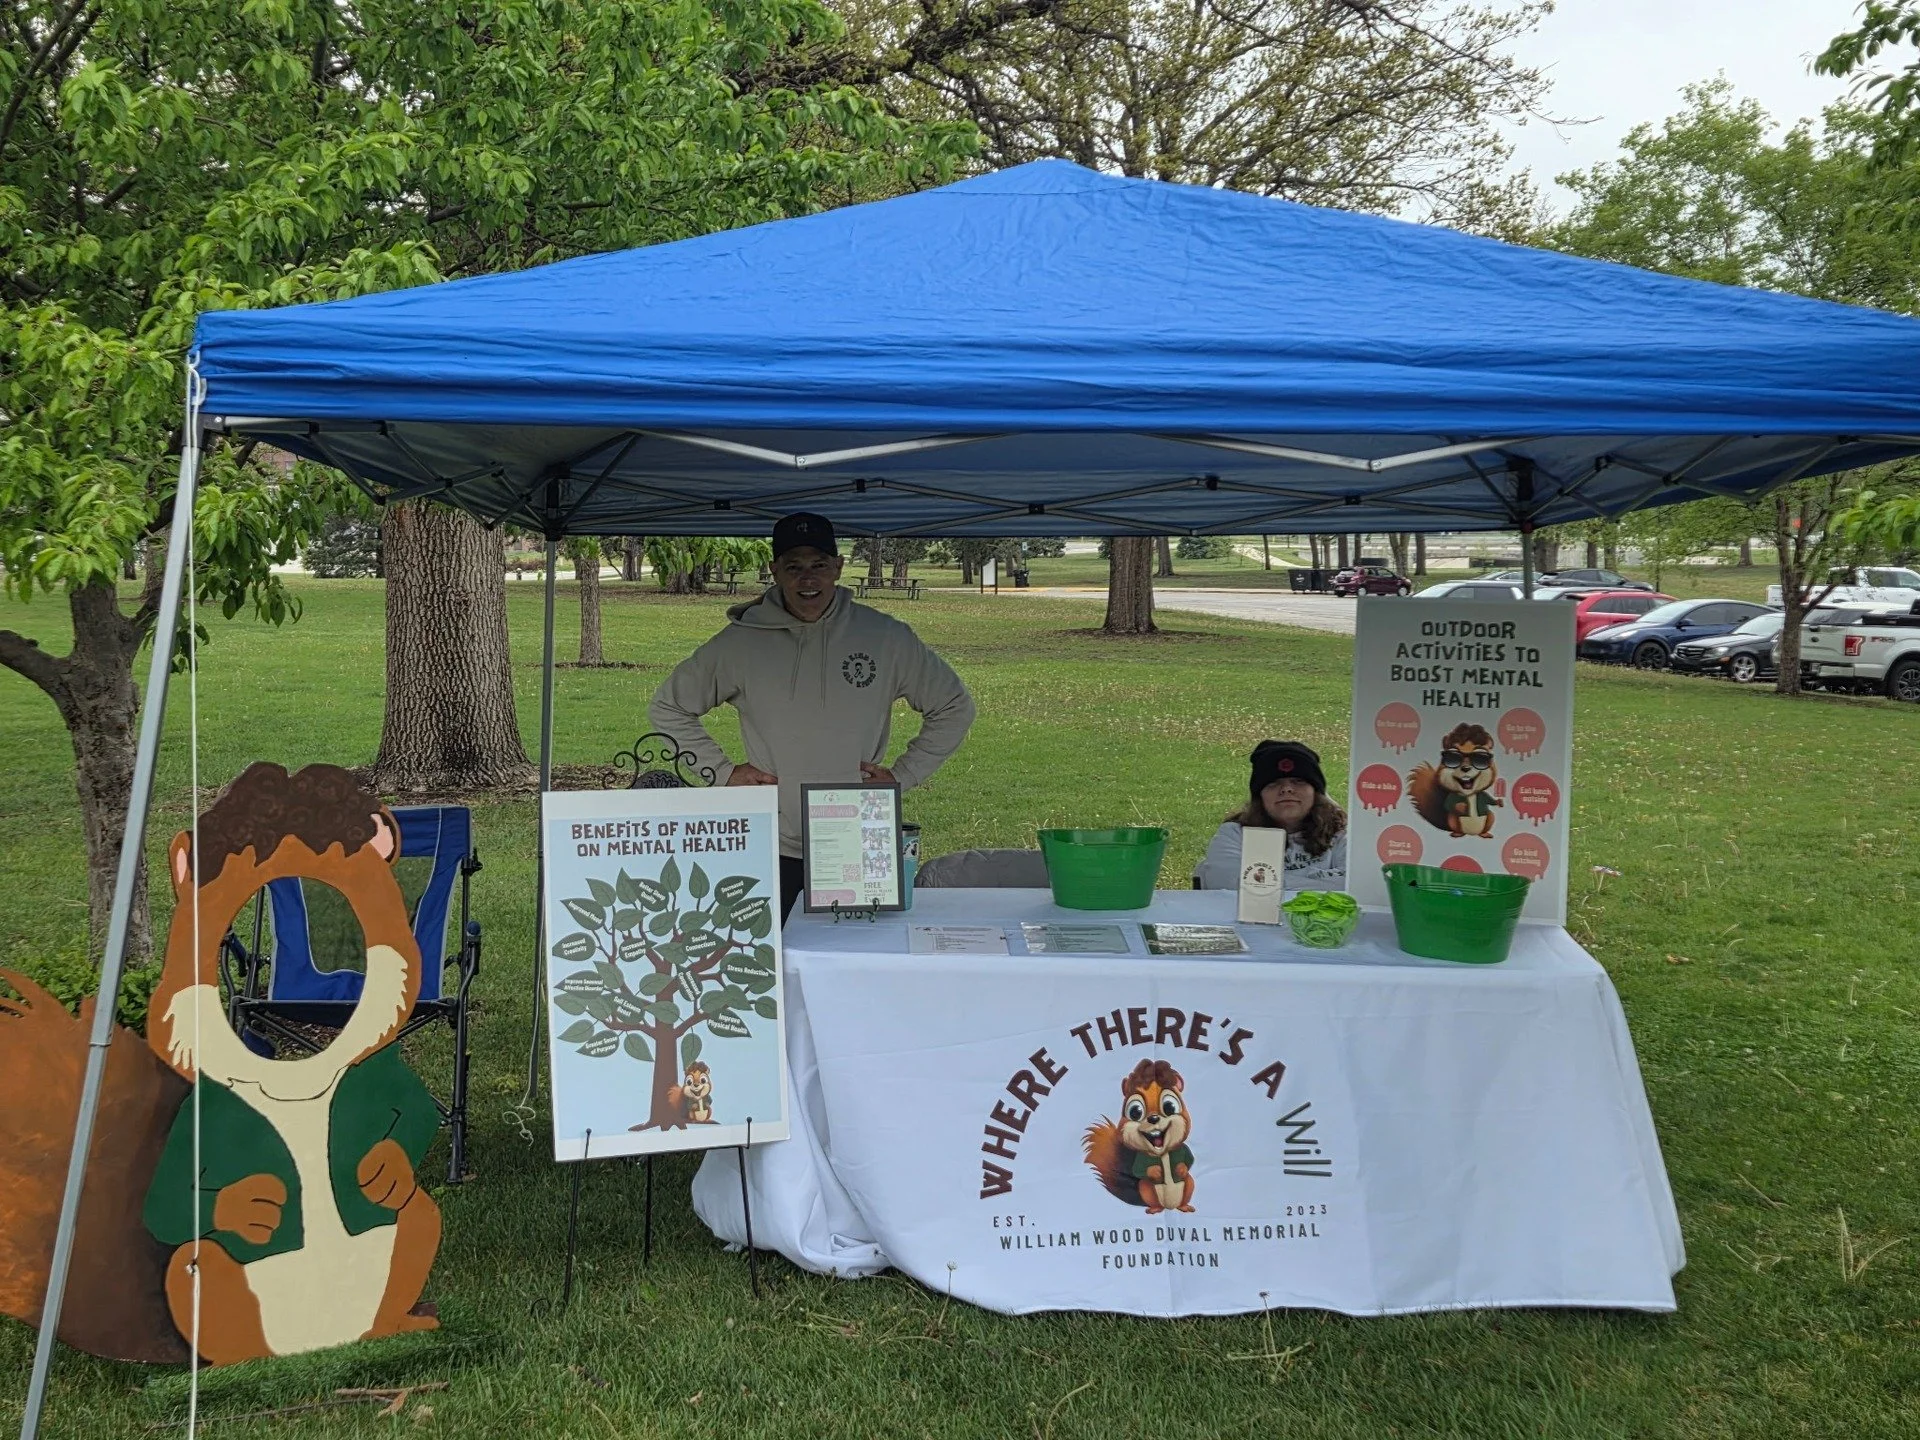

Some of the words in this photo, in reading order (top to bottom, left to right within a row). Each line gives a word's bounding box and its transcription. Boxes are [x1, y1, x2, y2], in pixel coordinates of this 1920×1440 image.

[1421, 620, 1516, 640] OUTDOOR
[1514, 646, 1540, 663] TO
[1391, 665, 1454, 684] BOOST
[1462, 668, 1543, 688] MENTAL
[1422, 689, 1500, 709] HEALTH
[658, 822, 679, 837] OF
[685, 818, 751, 835] NATURE
[577, 843, 600, 857] ON
[607, 839, 676, 855] MENTAL
[682, 836, 747, 852] HEALTH
[980, 1046, 1069, 1200] WHERE
[1070, 1007, 1254, 1066] THERE'S
[1251, 1060, 1286, 1100] A
[1276, 1101, 1333, 1178] Will
[1286, 1205, 1328, 1218] 2023
[993, 1215, 1036, 1229] EST.
[999, 1231, 1081, 1250] WILLIAM
[1092, 1226, 1146, 1246] WOOD
[1155, 1223, 1213, 1243] DUVAL
[1222, 1221, 1321, 1241] MEMORIAL
[1102, 1249, 1220, 1270] FOUNDATION
